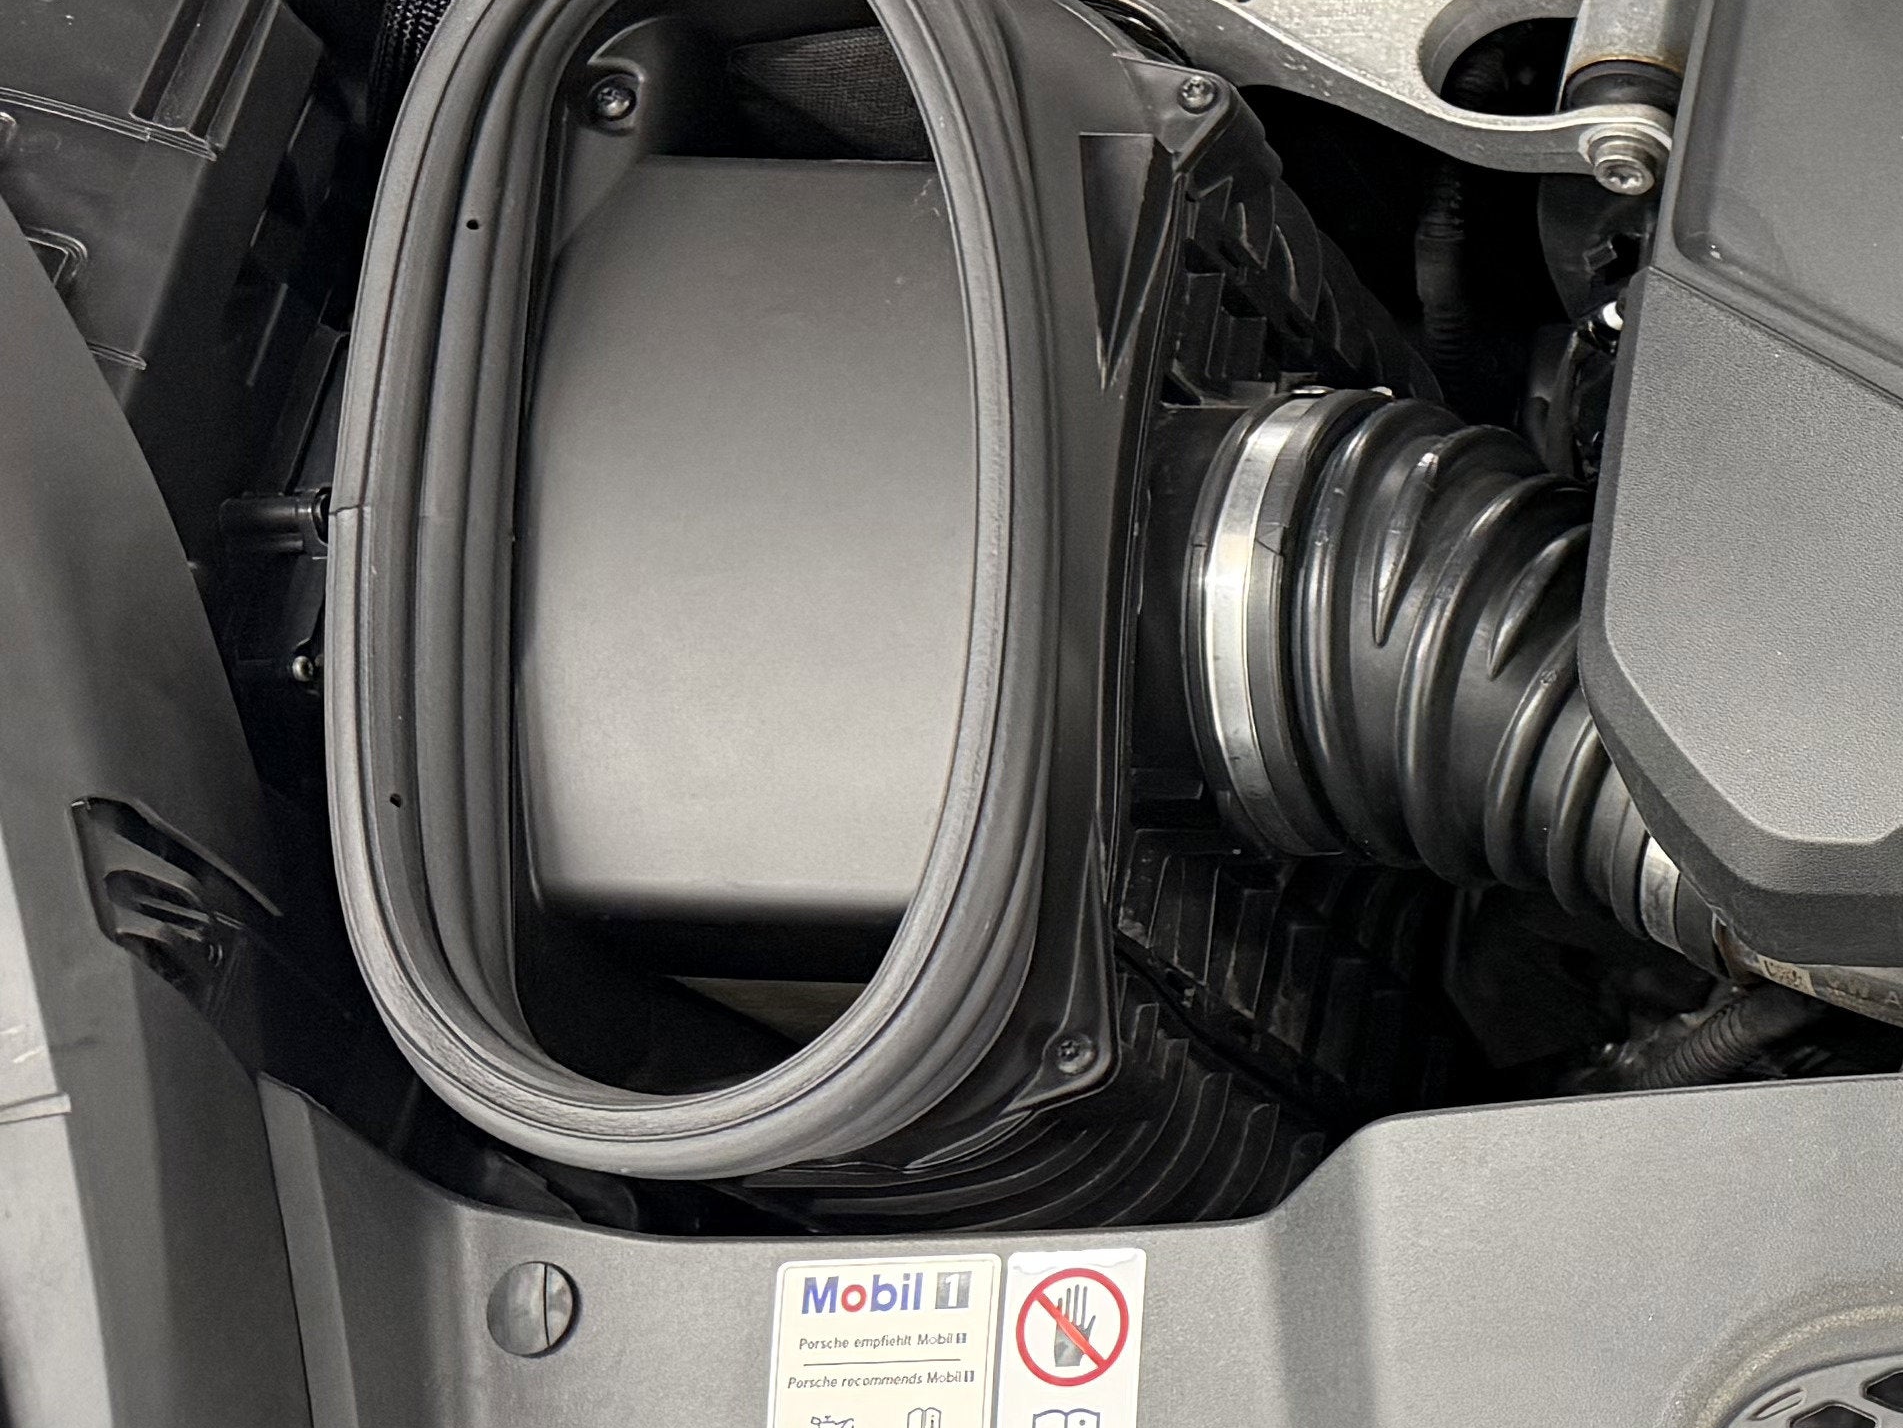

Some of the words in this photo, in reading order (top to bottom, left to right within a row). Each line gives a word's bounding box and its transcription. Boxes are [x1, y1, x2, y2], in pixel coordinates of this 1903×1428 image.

[801, 1272, 923, 1314] Mobil
[799, 1336, 849, 1350] Porsche
[854, 1334, 912, 1349] empfiehlt
[917, 1333, 953, 1346] Mobil
[788, 1374, 837, 1389] Porsche
[842, 1372, 923, 1388] recommends
[926, 1370, 962, 1384] Mobil
